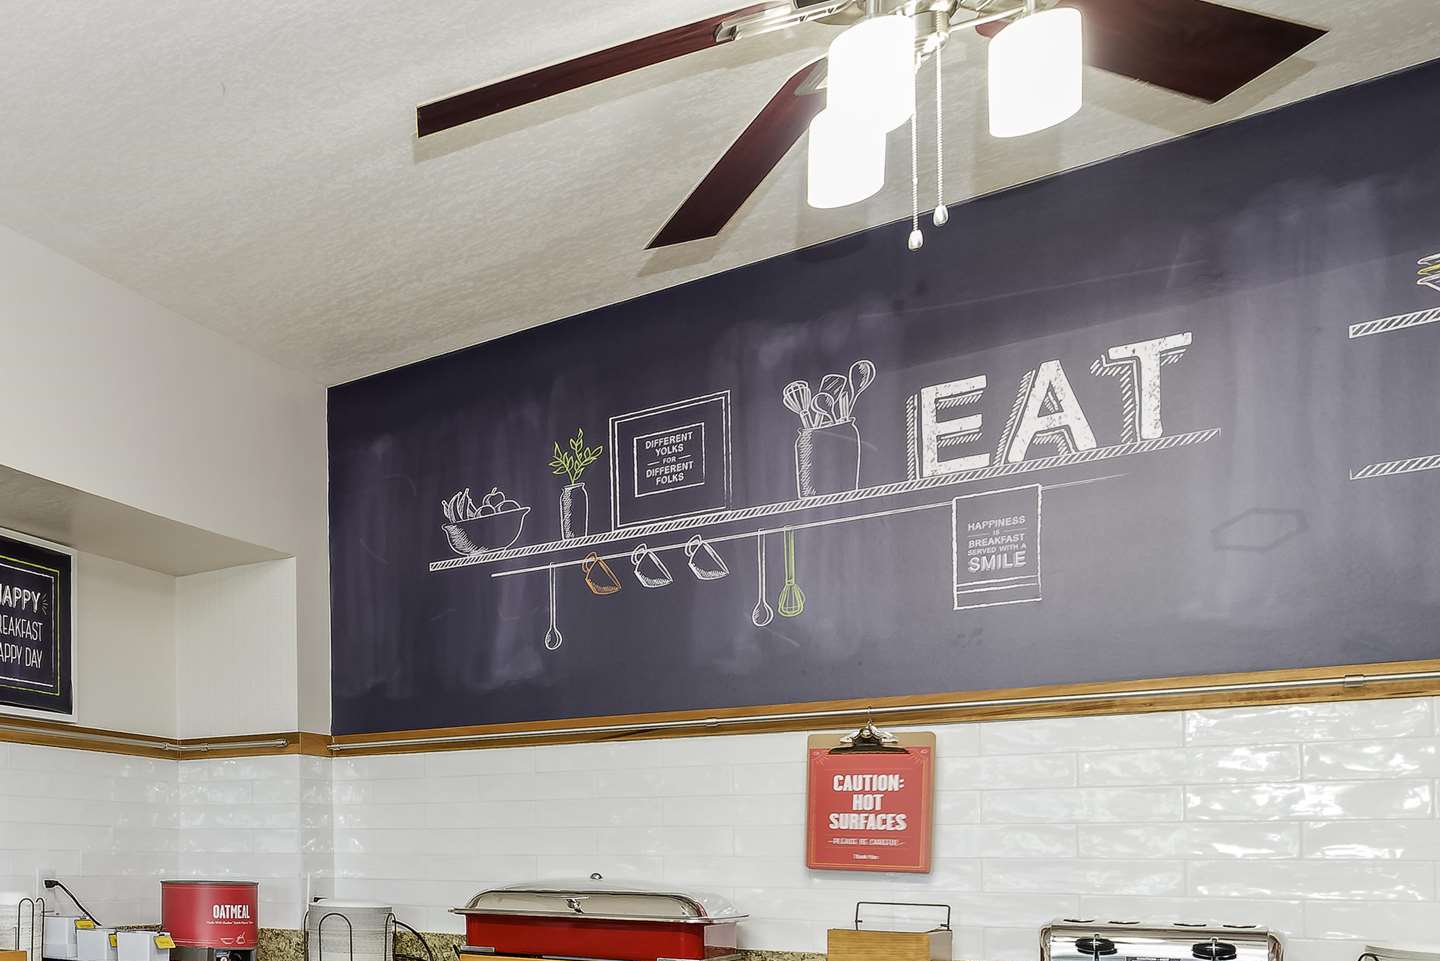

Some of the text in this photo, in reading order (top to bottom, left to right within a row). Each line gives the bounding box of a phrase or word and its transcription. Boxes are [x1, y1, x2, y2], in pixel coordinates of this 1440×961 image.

[906, 332, 1192, 480] EAT
[645, 431, 693, 449] DIFFERENT
[655, 443, 684, 456] YOLKS
[662, 456, 677, 464] FOR
[646, 461, 694, 478] DIFFERENT
[655, 472, 684, 486] FOLKS
[967, 515, 1026, 531] HAPPINESS
[968, 533, 1025, 549] BREAKFAST
[999, 543, 1019, 552] WITH
[968, 550, 1026, 573] SMILE
[25, 647, 42, 669] DAY
[833, 774, 905, 792] CAUTION:
[852, 794, 884, 811] HOT
[829, 813, 907, 831] SURFACES
[213, 905, 250, 919] OATMEAL
